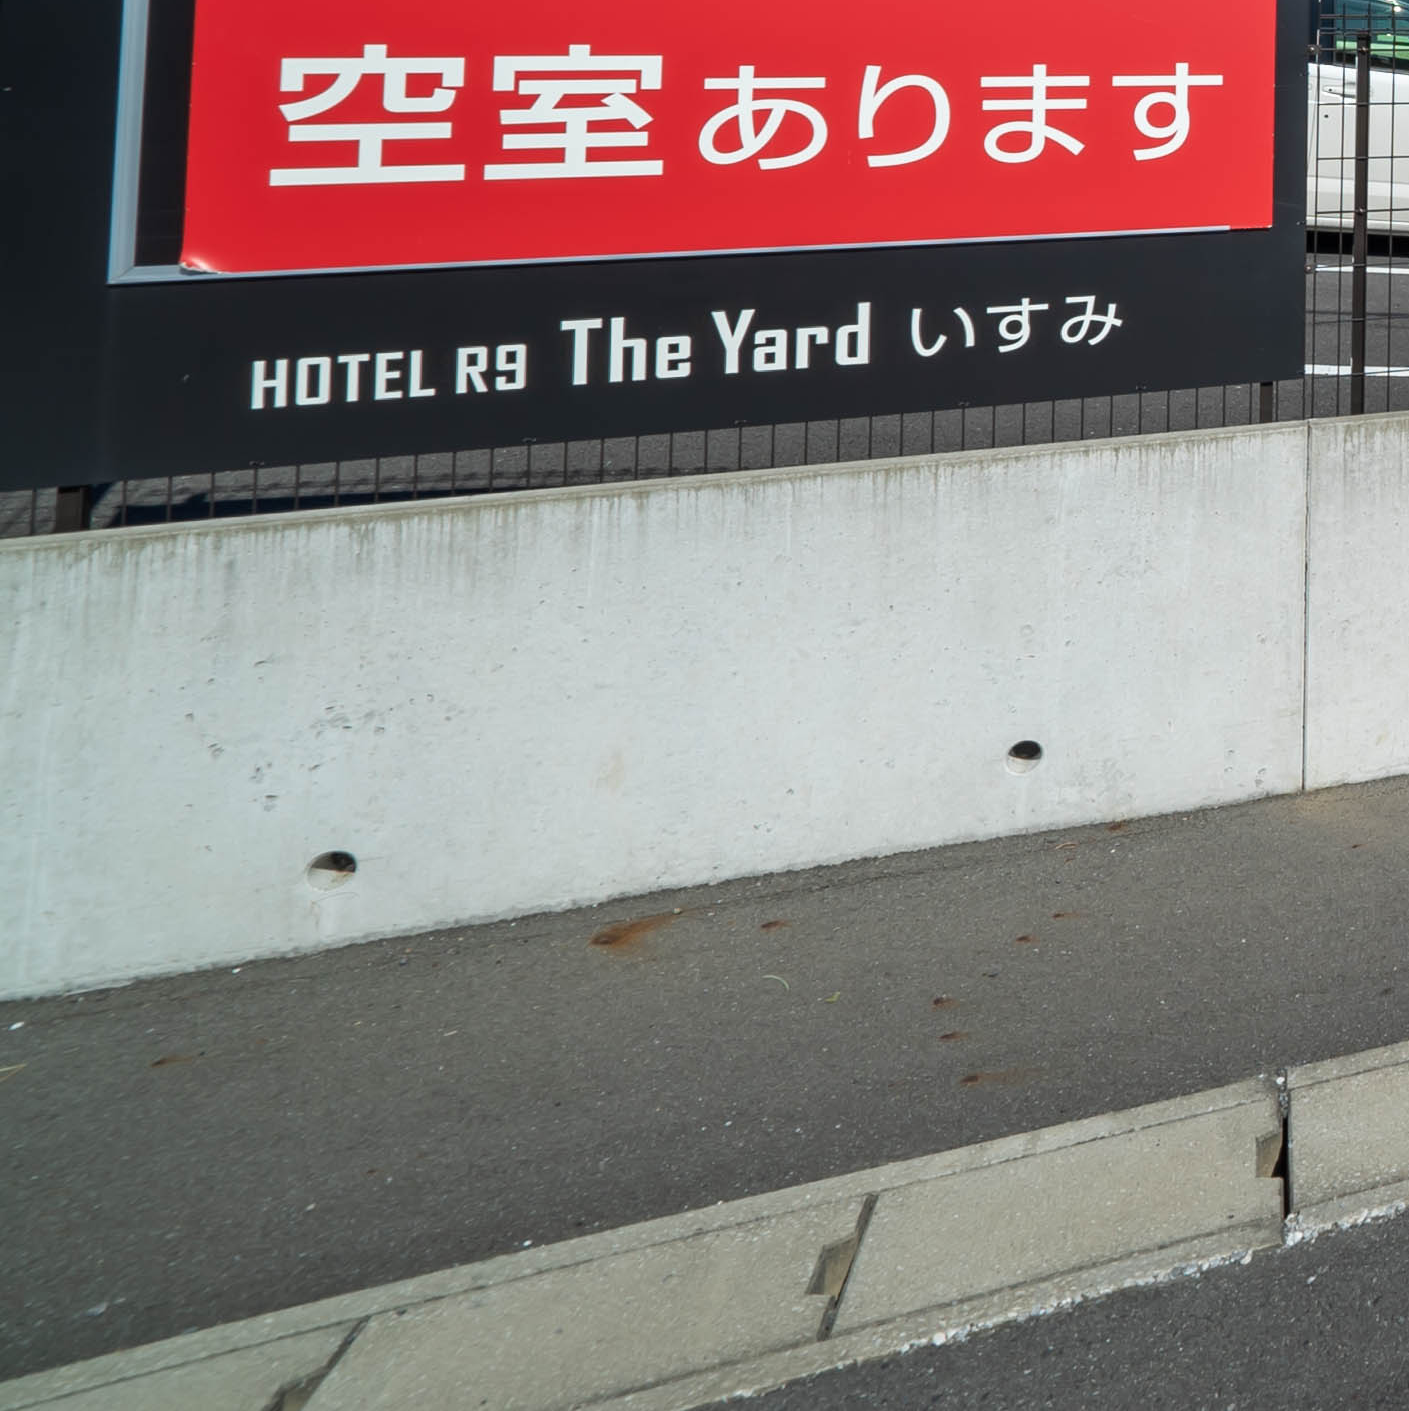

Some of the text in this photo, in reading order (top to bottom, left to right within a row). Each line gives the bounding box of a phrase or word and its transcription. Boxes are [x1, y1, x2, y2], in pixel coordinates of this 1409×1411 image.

[268, 43, 1224, 186] 空室あります
[250, 295, 1123, 410] HOTEL R9 The Yard いすみ
